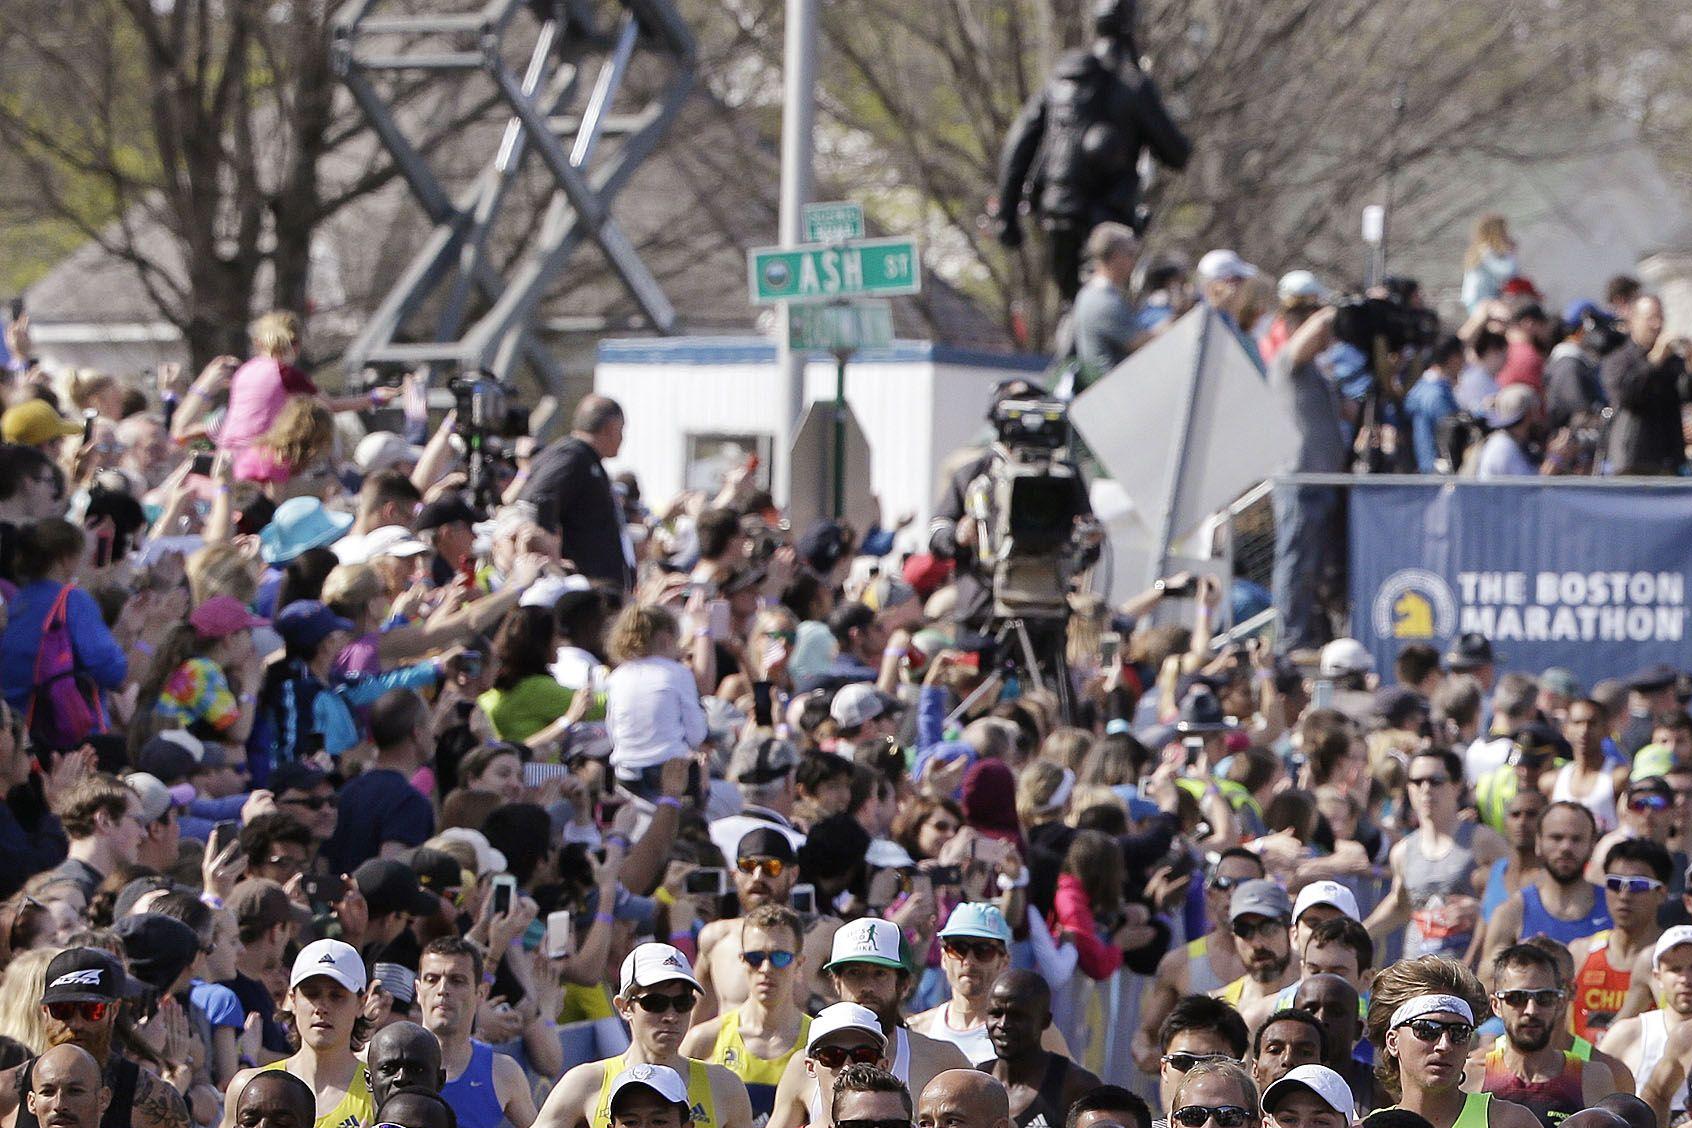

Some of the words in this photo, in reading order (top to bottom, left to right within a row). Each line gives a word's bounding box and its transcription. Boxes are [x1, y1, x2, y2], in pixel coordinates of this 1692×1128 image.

[799, 251, 863, 295] ASH
[883, 252, 909, 280] ST
[1457, 571, 1527, 605] THE
[1535, 571, 1685, 605] BOSTON
[1460, 606, 1685, 642] MARATHON
[1584, 988, 1628, 1010] CHI
